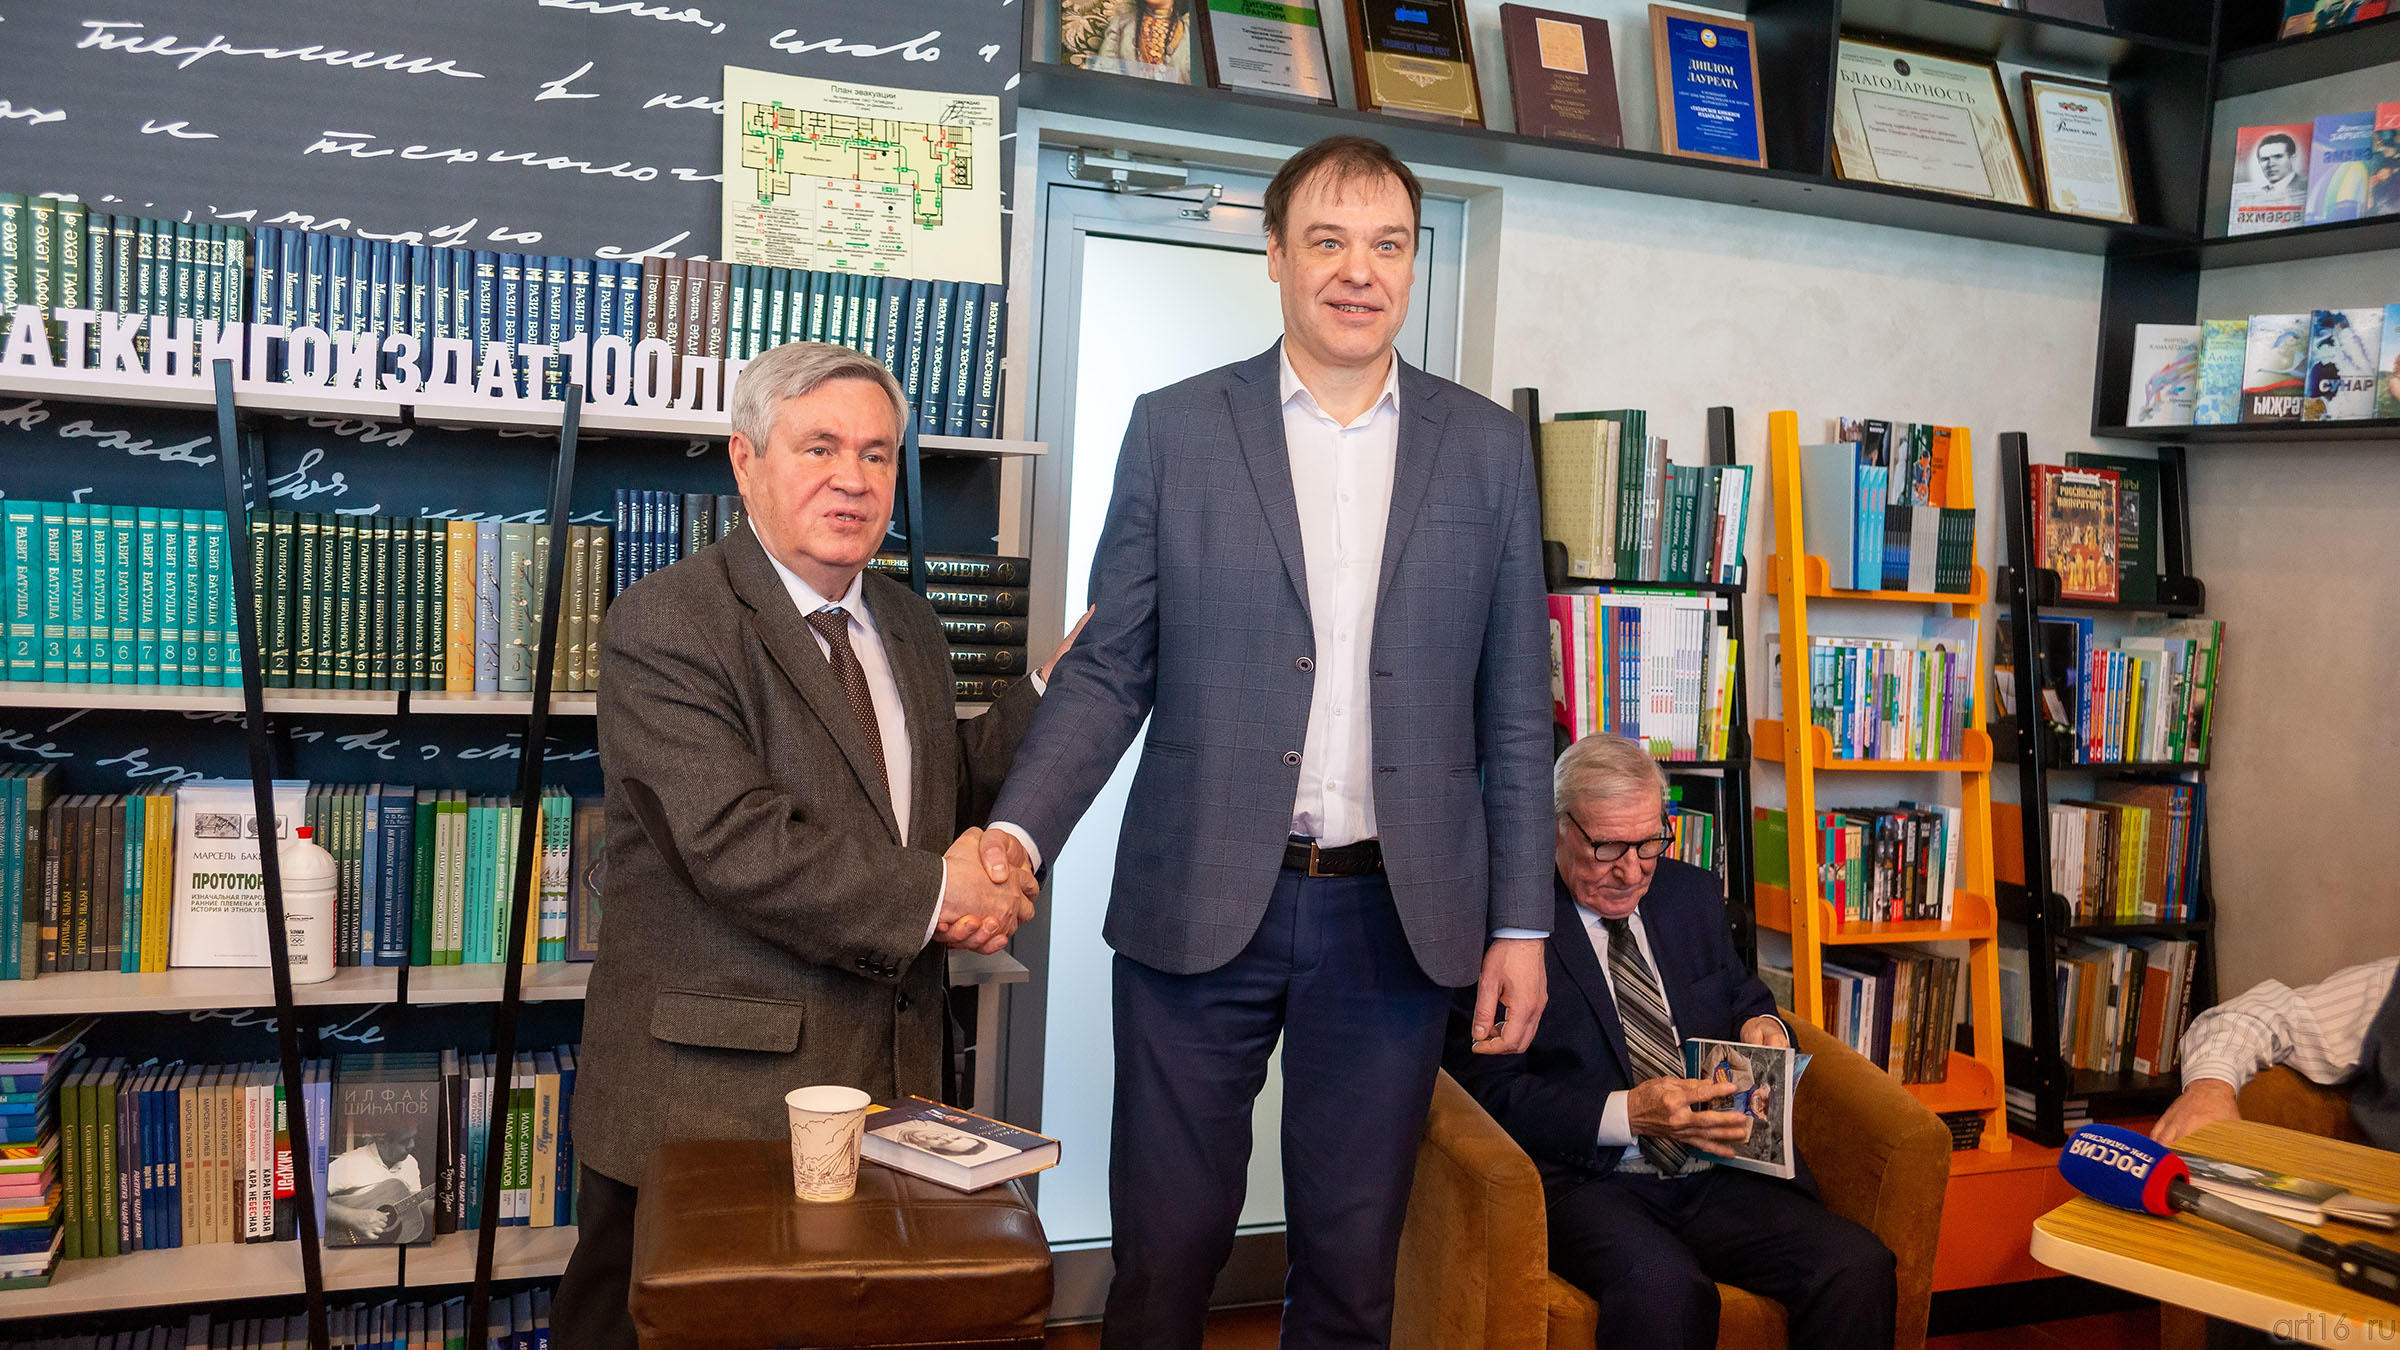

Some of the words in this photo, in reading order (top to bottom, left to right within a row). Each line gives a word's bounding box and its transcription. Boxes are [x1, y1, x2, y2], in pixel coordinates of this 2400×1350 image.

[1687, 72, 1738, 90] ЛАУРЕАТА
[1689, 59, 1734, 75] ДИПЛОМ
[830, 84, 851, 96] План
[854, 88, 897, 101] эвакуации
[1840, 69, 1976, 104] БЛАГОДАРНОСТЬ
[63, 272, 77, 309] ГАФФ
[480, 280, 492, 319] РАЗИЛ
[504, 283, 515, 317] РАЗИЛ
[528, 283, 540, 318] РАЗИЛ
[550, 286, 561, 320] РАЗИЛ
[574, 287, 586, 321] РАЗИЛ
[600, 290, 612, 324] РАЗИЛ
[623, 292, 635, 326] РАЗИЛ
[527, 321, 538, 344] ВӘЛ
[2318, 379, 2374, 393] СУНАР
[16, 526, 27, 562] РАБИТ
[48, 528, 59, 564] РАБИТ
[72, 530, 82, 565] РАБИТ
[95, 530, 105, 565] РАБИТ
[118, 532, 129, 567] РАБИТ
[143, 533, 154, 567] РАБИТ
[166, 533, 176, 569] РАБИТ
[188, 535, 198, 569] РАБИТ
[209, 536, 219, 570] РАБИТ
[16, 566, 28, 618] БАТУЛЛА
[48, 567, 60, 619] БАТУЛЛА
[72, 568, 83, 620] БАТУЛЛА
[95, 569, 106, 621] БАТУЛЛА
[118, 571, 129, 623] БАТУЛЛА
[142, 571, 154, 623] БАТУЛЛА
[166, 572, 177, 624] БАТУЛЛА
[187, 573, 198, 625] БАТУЛЛА
[208, 573, 219, 625] БАТУЛЛА
[18, 641, 28, 655] 2
[49, 642, 59, 656] 3
[73, 644, 83, 657] 4
[95, 644, 104, 656] 5
[119, 646, 128, 659] 6
[142, 646, 152, 659] 7
[165, 646, 175, 659] 8
[187, 647, 197, 660] 9
[208, 647, 218, 661] 9
[276, 658, 285, 668] 2
[300, 657, 309, 667] 3
[321, 658, 330, 668] 4
[339, 659, 348, 669] 5
[357, 660, 366, 671] 6
[376, 660, 383, 671] 7
[396, 660, 405, 671] 8
[415, 660, 423, 670] 9
[431, 662, 443, 672] 10
[552, 817, 561, 857] КАЗАНЬ
[561, 817, 570, 857] КАЗАНЬ
[193, 852, 236, 860] МАРСЕЛЬ
[192, 873, 264, 890] ПРОТОТЮР
[185, 1100, 193, 1131] МАРСЕЛЬ
[202, 1098, 210, 1130] МАРСЕЛЬ
[344, 1102, 428, 1116] ШИҺАПОВ
[521, 1112, 529, 1139] ИЛДУС
[185, 1132, 193, 1158] ГАЛИЕВ
[203, 1131, 211, 1156] ГАЛИЕВ
[2069, 1139, 2149, 1178] РОССИЯ
[2130, 1148, 2154, 1162] ГТРК
[248, 1169, 257, 1189] КАРА
[262, 1169, 271, 1188] КАРА
[519, 1141, 528, 1185] ДИНДАРОВ
[248, 1191, 258, 1233] НЕБЕСНАЯ
[262, 1190, 271, 1232] НЕБЕСНАЯ
